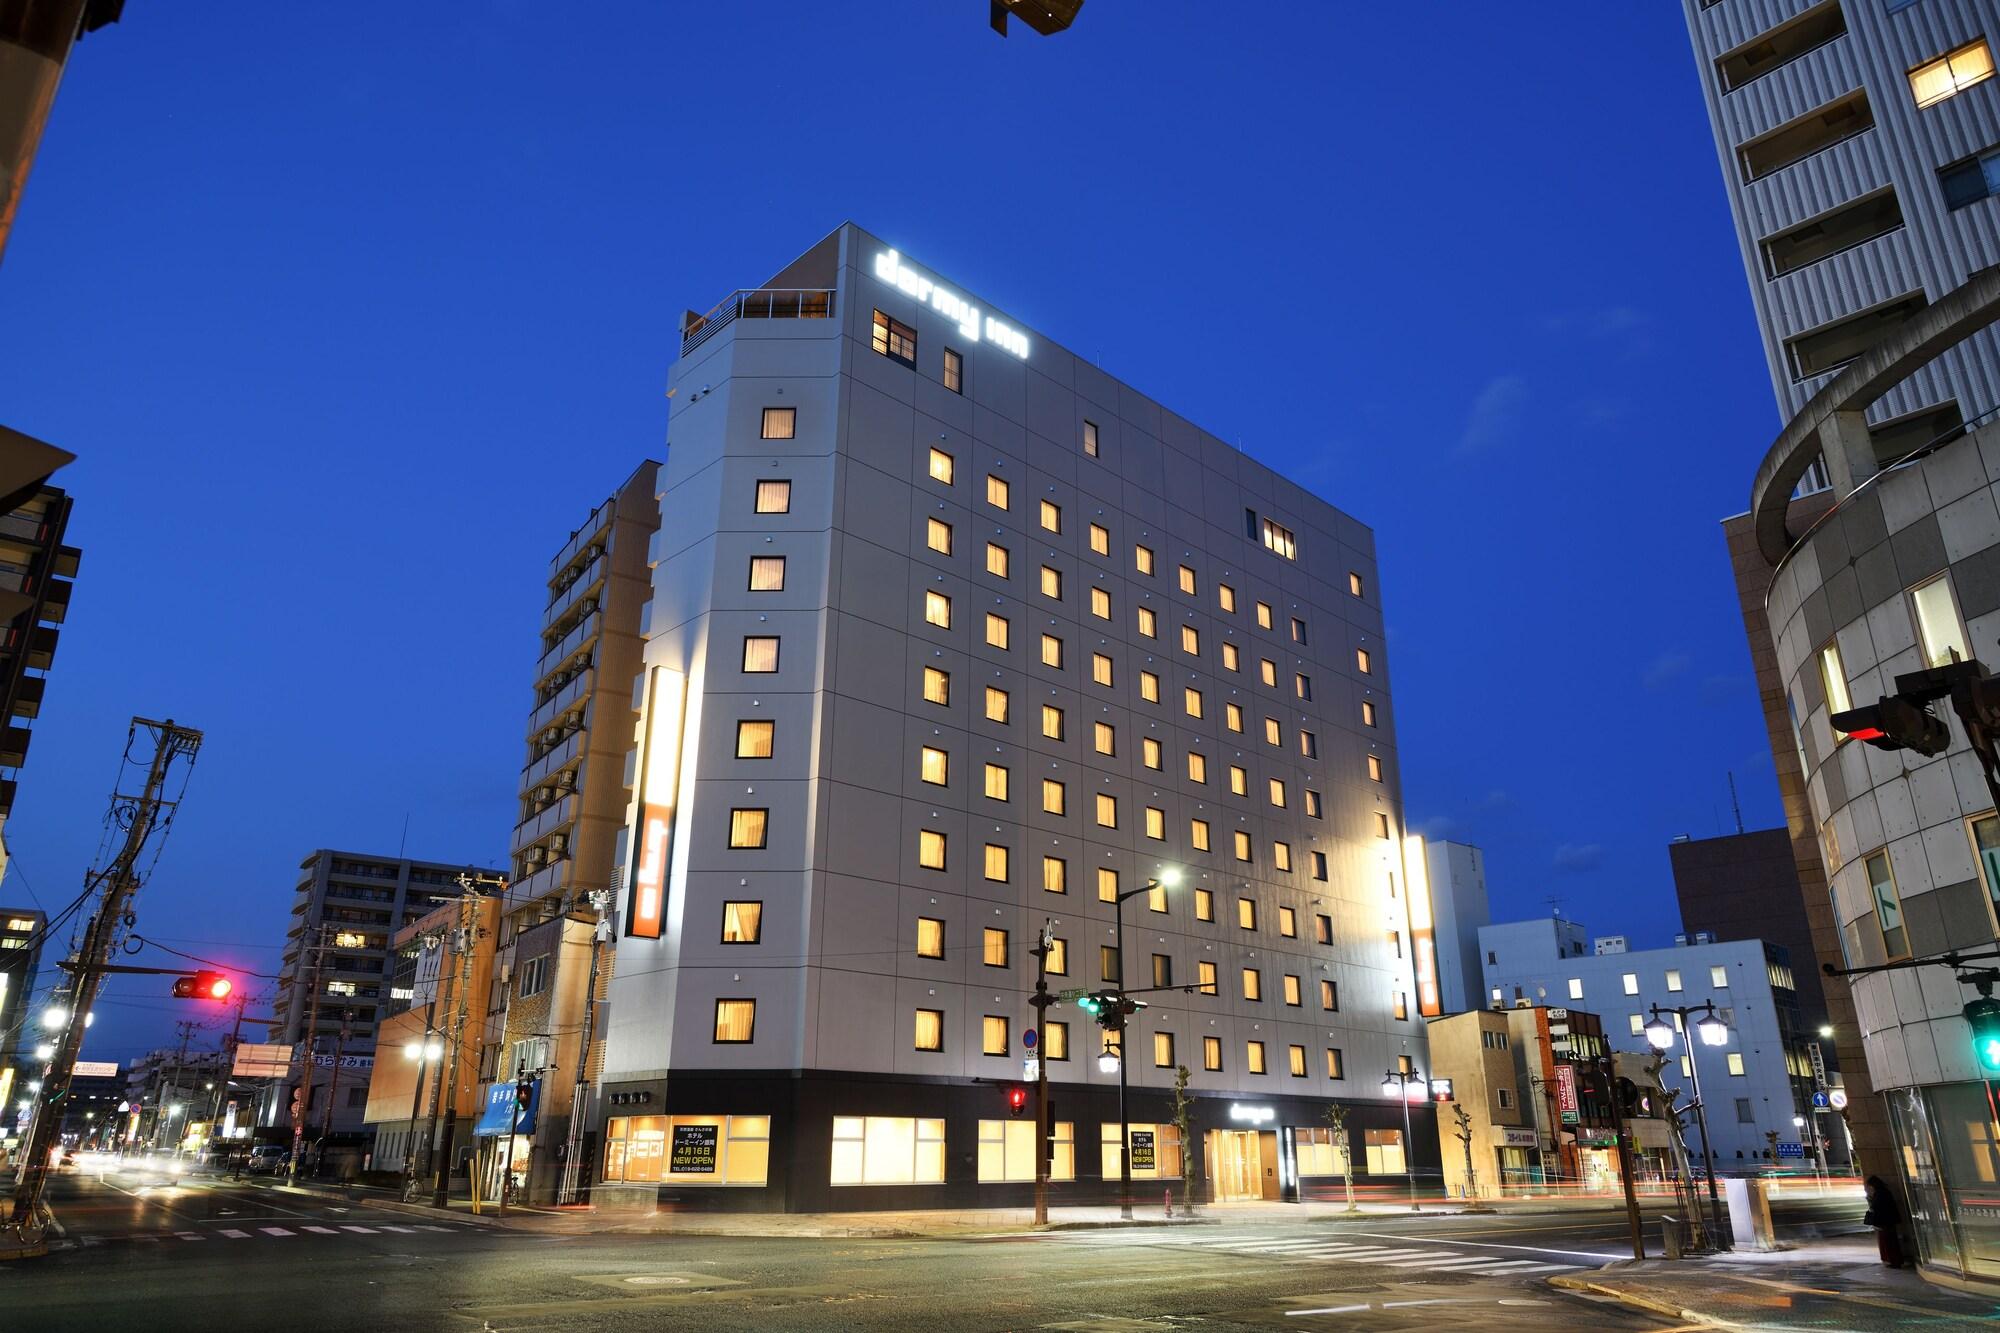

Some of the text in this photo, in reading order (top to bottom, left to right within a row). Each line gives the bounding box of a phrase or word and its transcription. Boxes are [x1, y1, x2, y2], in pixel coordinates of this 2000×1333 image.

[876, 249, 1028, 358] dormy inn
[673, 1156, 714, 1164] NEW OPEN
